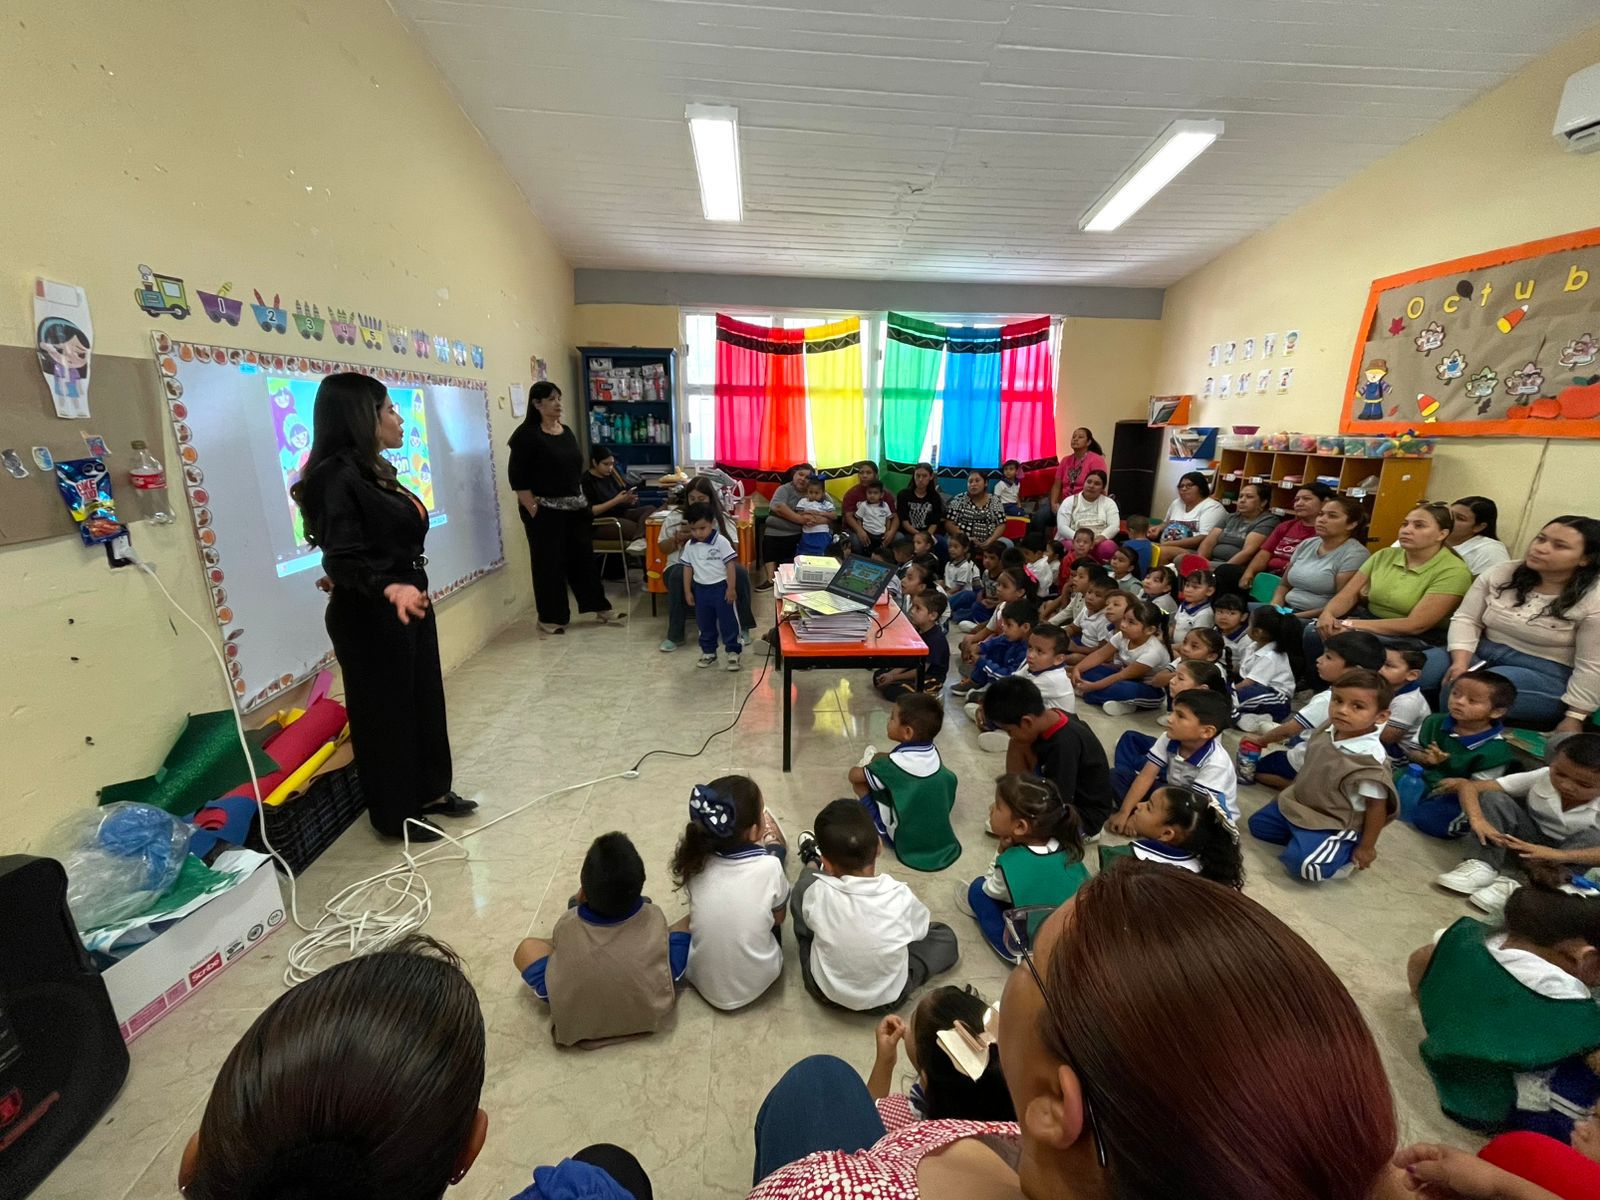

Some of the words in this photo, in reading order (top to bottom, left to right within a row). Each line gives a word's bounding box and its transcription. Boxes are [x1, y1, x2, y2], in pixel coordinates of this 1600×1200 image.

[217, 297, 226, 314] 1
[266, 309, 277, 323] 2
[305, 317, 315, 331] 3
[341, 323, 349, 336] 4
[369, 329, 377, 341] 5
[191, 958, 221, 982] Scribe
